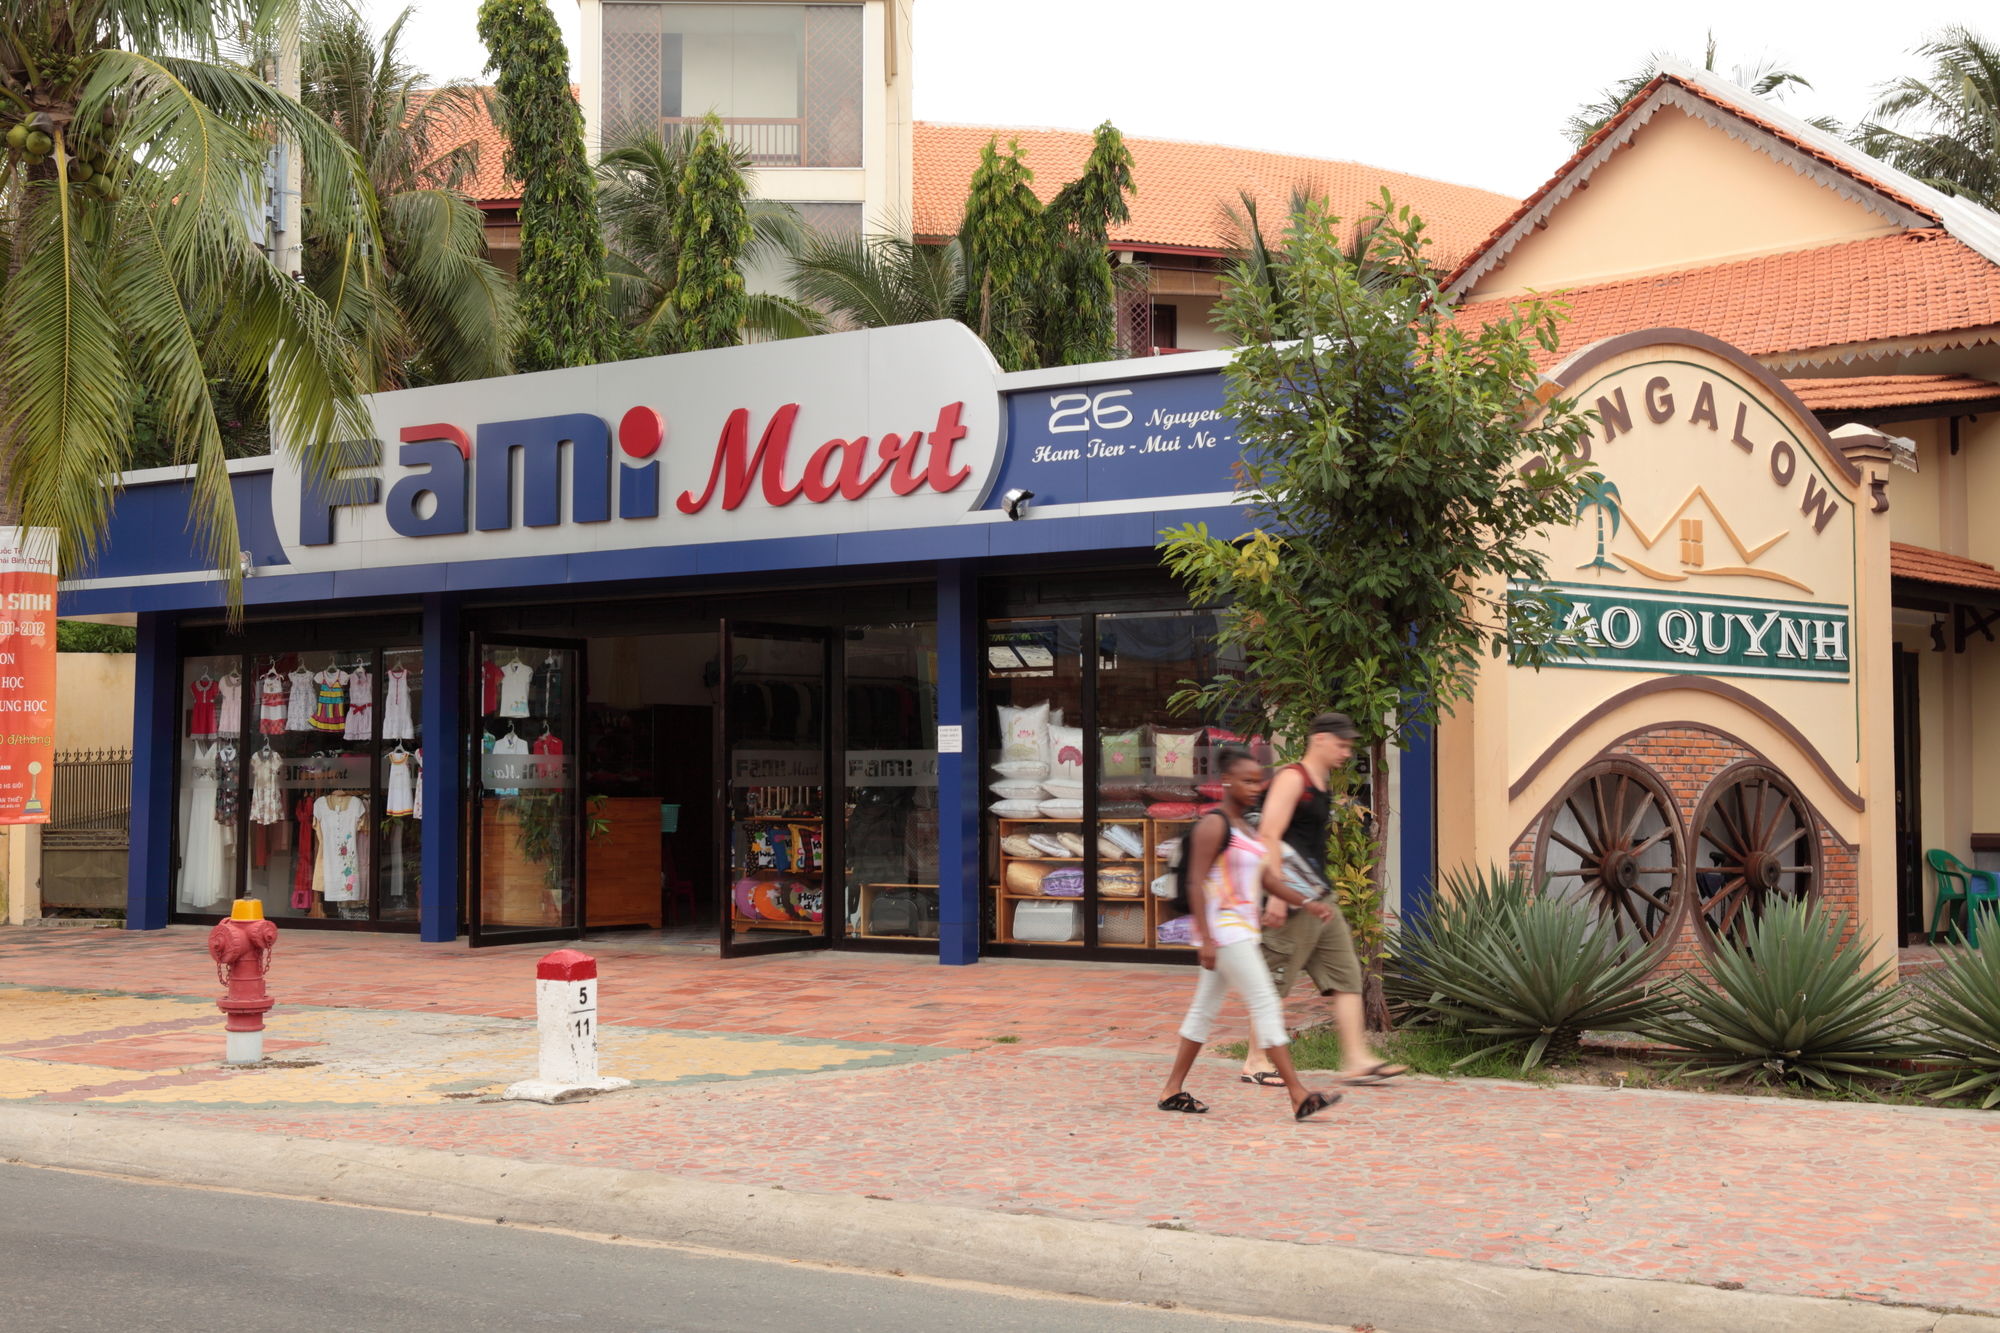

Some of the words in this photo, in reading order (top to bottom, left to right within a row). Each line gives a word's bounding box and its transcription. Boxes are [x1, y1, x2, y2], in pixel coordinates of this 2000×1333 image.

[1048, 389, 1133, 434] 26
[1145, 408, 1222, 430] Nguyen
[1031, 446, 1081, 463] Ham
[1086, 438, 1125, 458] Tien
[1139, 435, 1181, 454] Mui
[1188, 431, 1217, 449] Ne
[299, 404, 665, 546] Fami
[675, 400, 972, 514] Mart
[1658, 609, 1848, 661] QUYNH
[1, 676, 25, 691] HỌC
[23, 699, 48, 715] HỌC
[848, 759, 913, 778] Fami
[579, 987, 588, 1005] 5
[575, 1018, 592, 1038] 11
